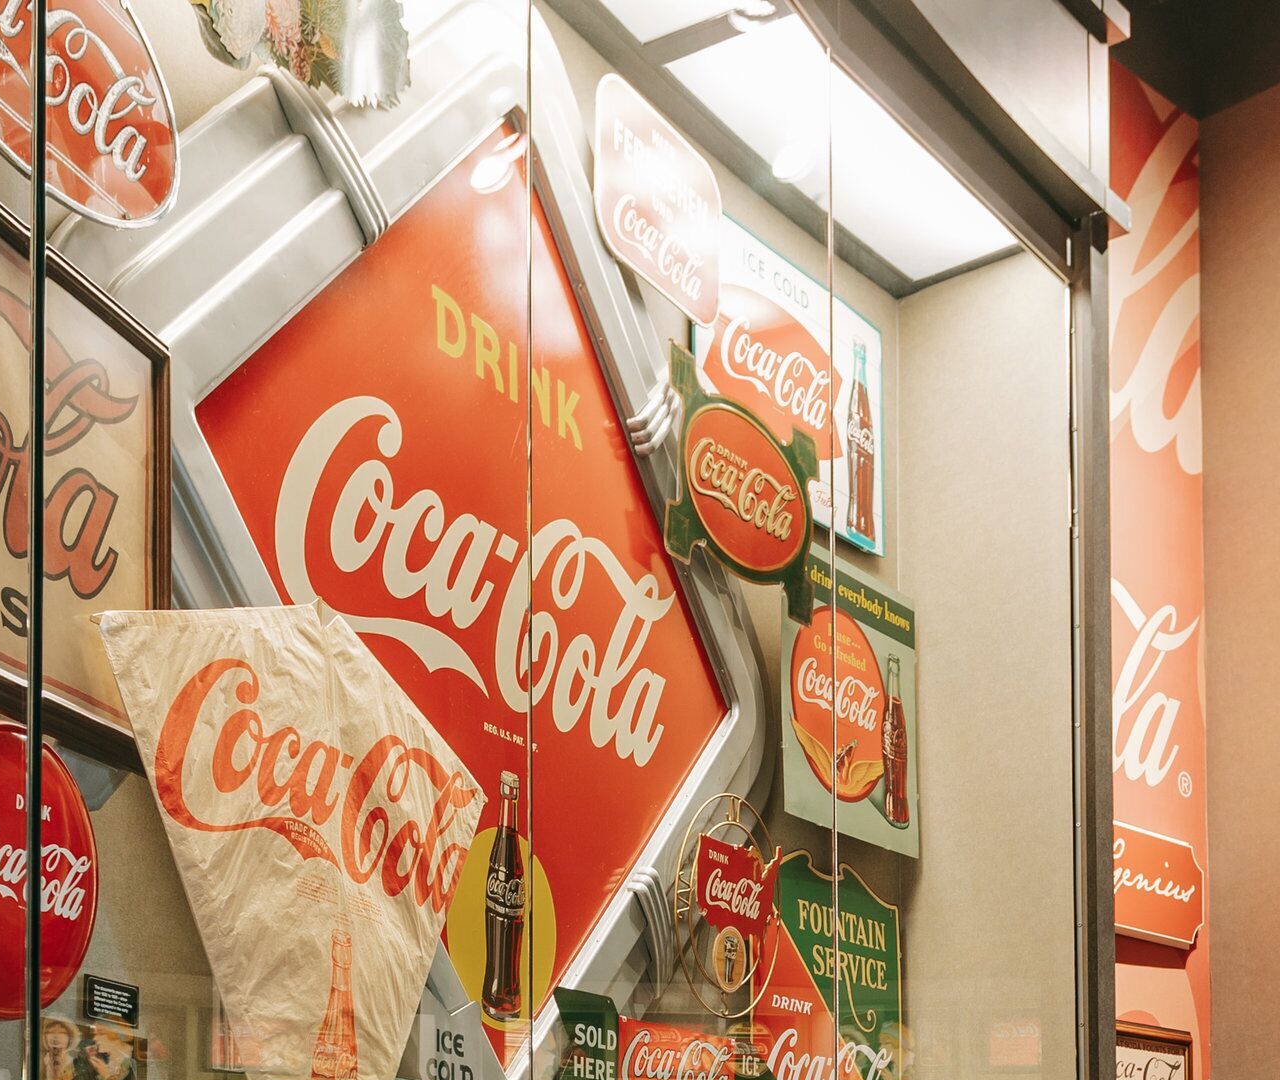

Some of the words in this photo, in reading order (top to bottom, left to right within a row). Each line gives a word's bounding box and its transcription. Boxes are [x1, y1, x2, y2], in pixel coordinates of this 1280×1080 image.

[742, 248, 766, 280] ICE
[772, 271, 810, 309] COLD
[431, 283, 584, 451] DRINK
[721, 315, 831, 431] Coca-Cola
[714, 445, 748, 471] DRINK
[689, 437, 797, 542] Coca-Cola
[274, 395, 677, 768] Coca-Cola
[838, 582, 883, 619] everybody
[884, 601, 911, 632] knows
[797, 657, 880, 732] Coca-Cola
[483, 721, 499, 736] REG.
[512, 733, 525, 747] PAT.
[154, 657, 480, 914] Coca-Cola
[283, 820, 308, 836] TRADE
[708, 848, 730, 866] DRINK
[705, 868, 764, 920] Coca-Cola
[797, 898, 887, 953] FOUNTAIN
[812, 942, 888, 992] SERVICE
[770, 994, 813, 1017] DRINK
[435, 1028, 465, 1058] ICE
[573, 1022, 617, 1052] SOLD
[741, 1053, 760, 1077] ICE
